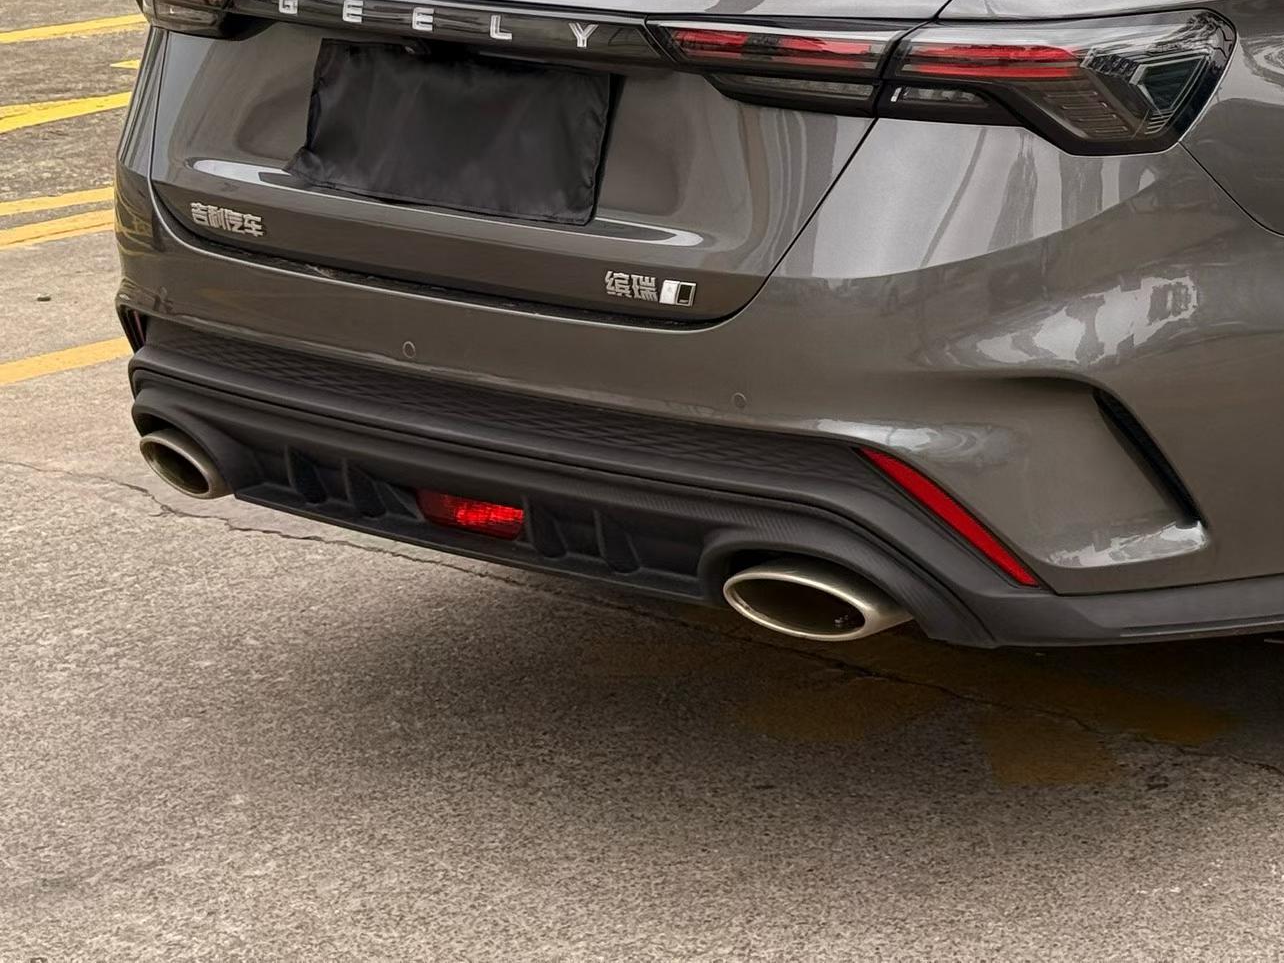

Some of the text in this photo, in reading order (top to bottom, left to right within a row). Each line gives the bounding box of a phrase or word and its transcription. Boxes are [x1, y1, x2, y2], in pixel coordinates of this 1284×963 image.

[190, 202, 264, 237] 吉利汽车
[605, 270, 658, 302] 缤瑞
